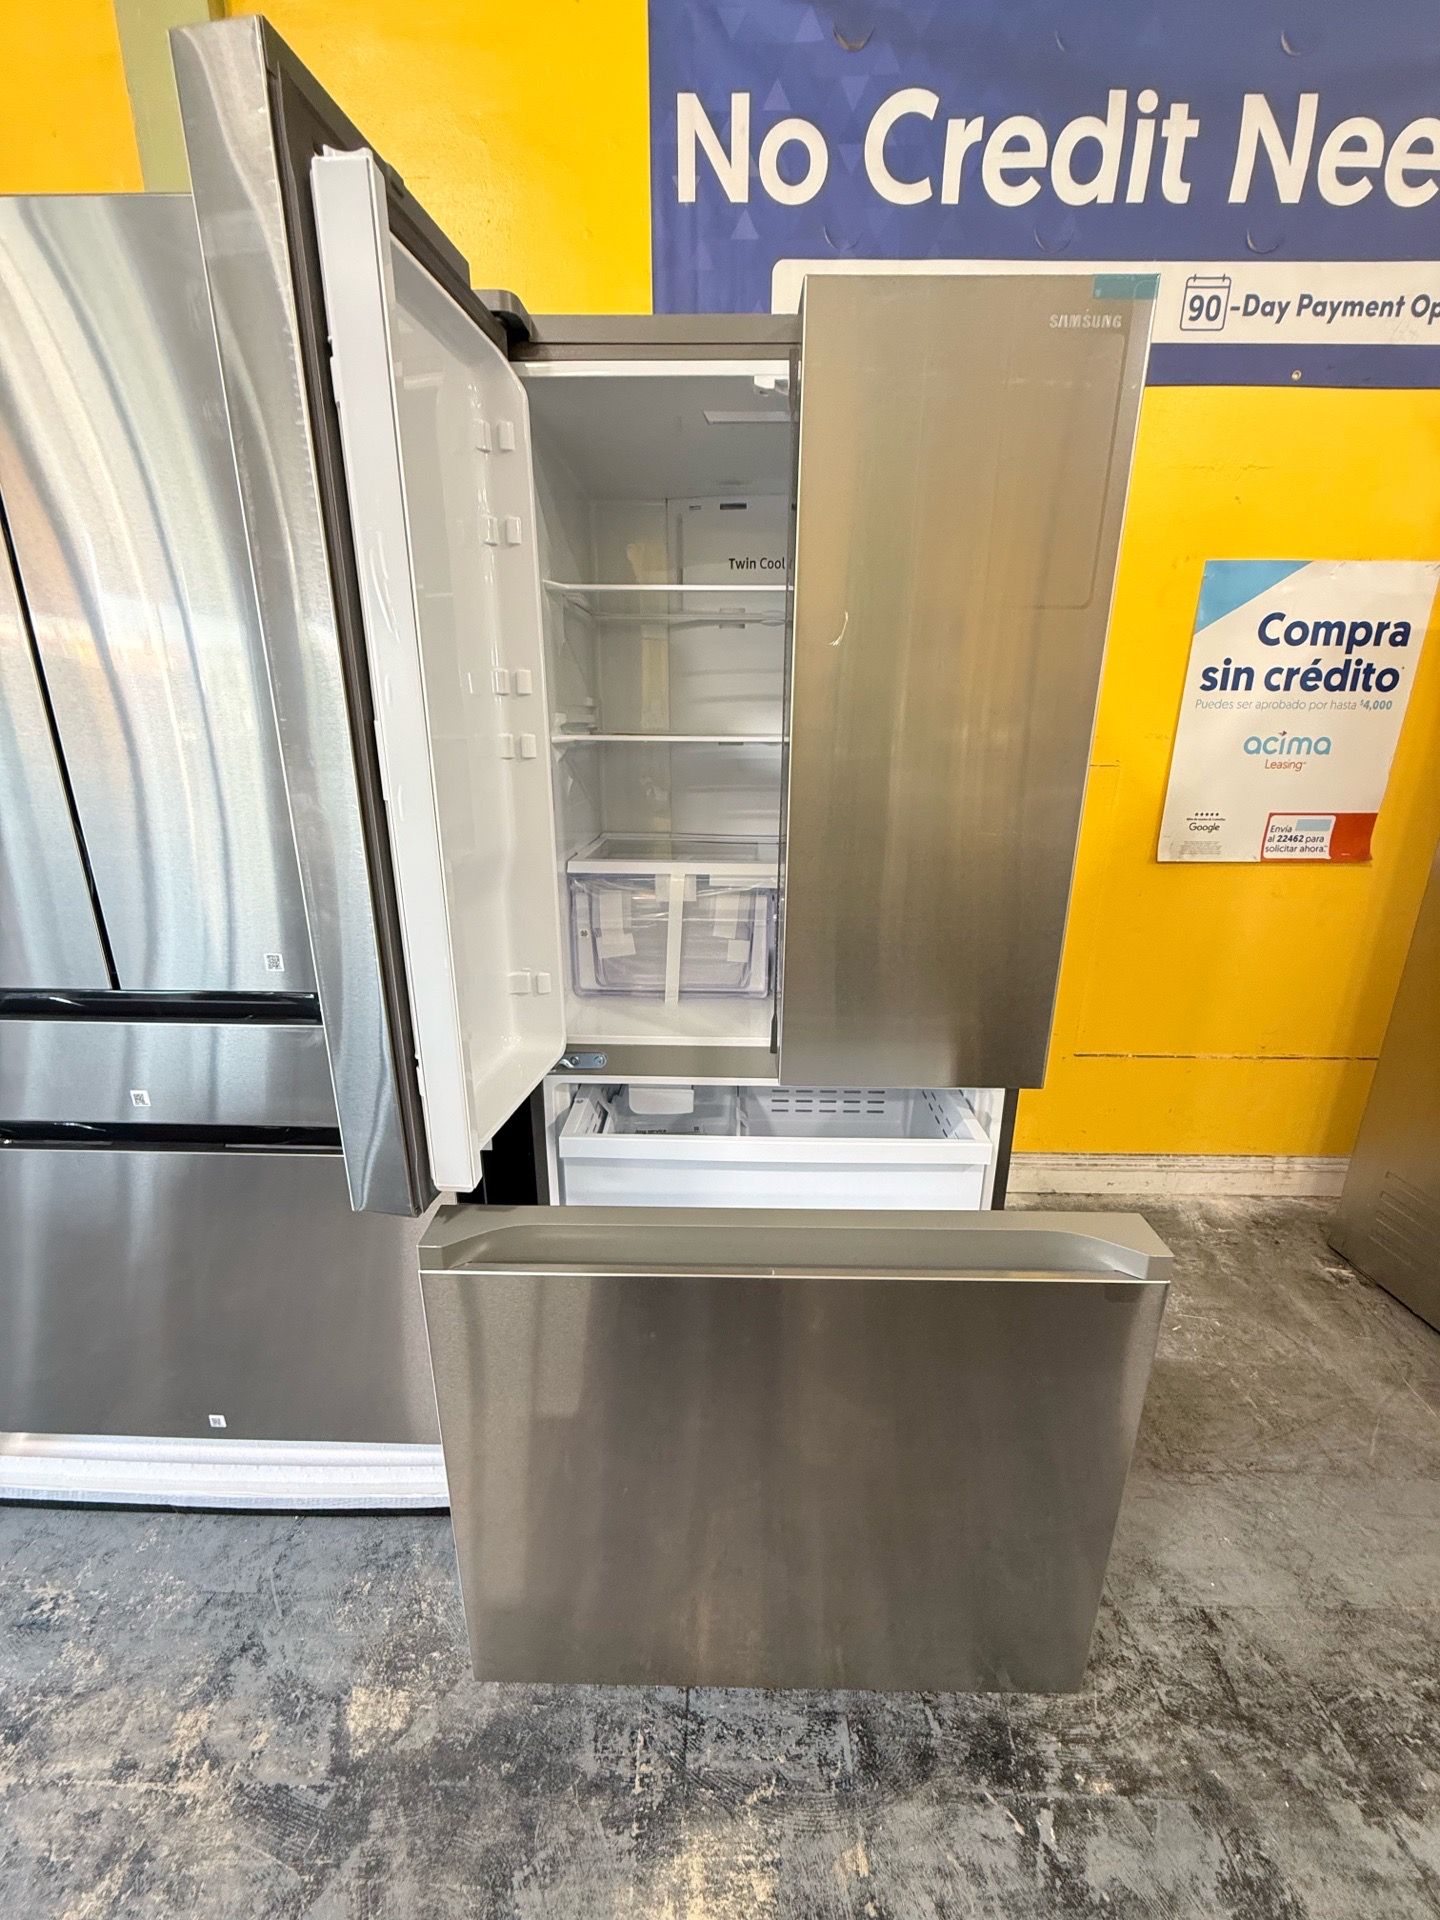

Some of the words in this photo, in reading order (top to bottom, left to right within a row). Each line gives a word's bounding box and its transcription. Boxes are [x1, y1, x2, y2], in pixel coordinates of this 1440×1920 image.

[677, 92, 828, 206] No
[864, 88, 1200, 207] Credit
[1228, 92, 1440, 208] Nee
[1296, 294, 1405, 324] Payment
[1049, 314, 1122, 328] SAMSUNG
[728, 557, 757, 570] Twin
[759, 557, 786, 570] Cool
[1257, 612, 1411, 654] Compra
[1199, 657, 1255, 692] sin
[1264, 658, 1400, 693] crédito
[1195, 699, 1233, 710] Puedes
[1236, 701, 1251, 710] ser
[1255, 699, 1306, 711] aprobado
[1308, 701, 1328, 711] por
[1329, 699, 1357, 710] hasta
[1243, 735, 1332, 756] acima
[1189, 822, 1220, 833] Google
[1267, 835, 1275, 843] al
[1277, 834, 1304, 843] 22462
[1305, 835, 1325, 844] para
[1265, 845, 1297, 853] solicitar
